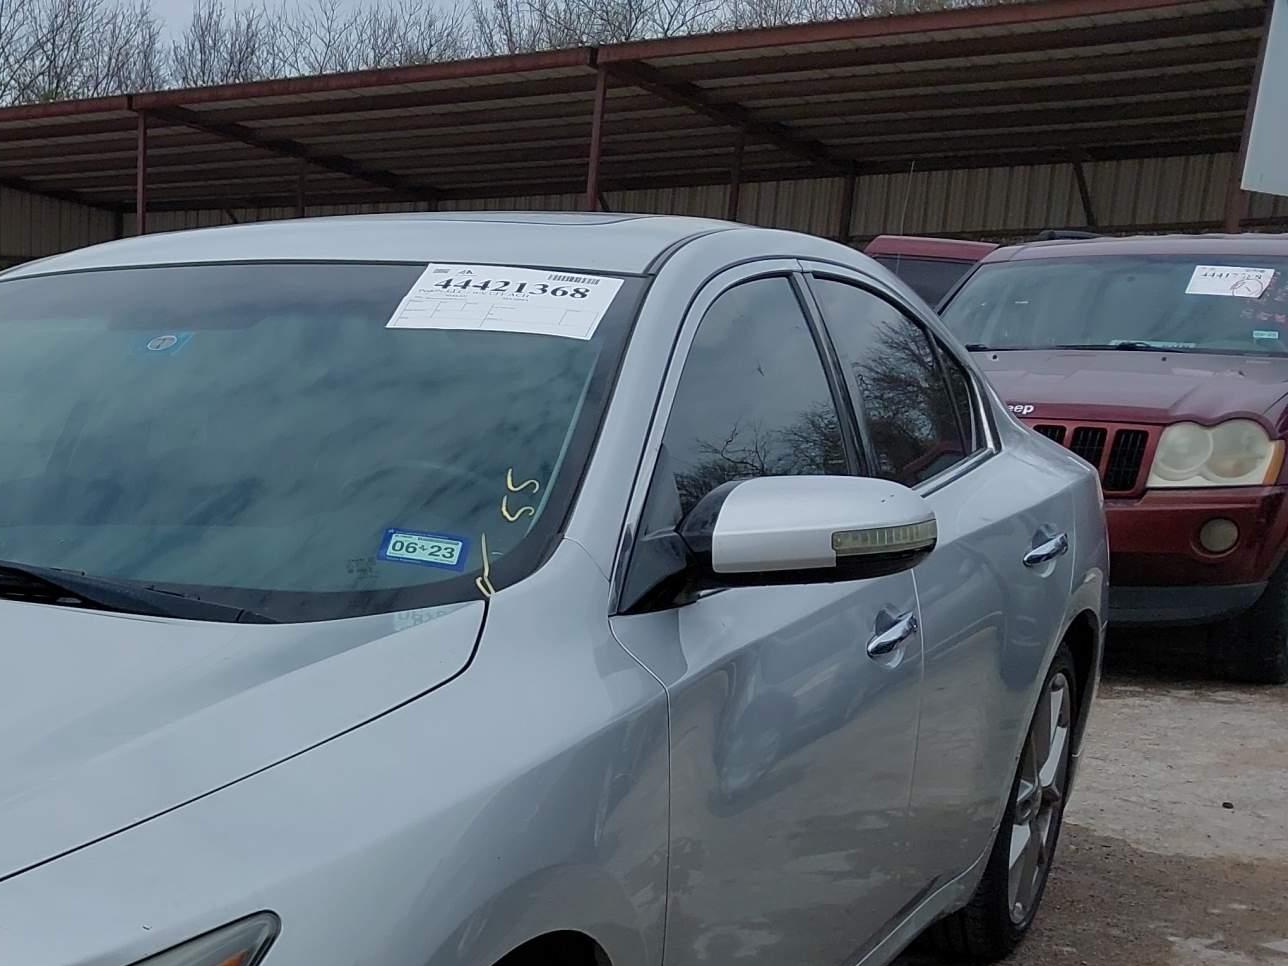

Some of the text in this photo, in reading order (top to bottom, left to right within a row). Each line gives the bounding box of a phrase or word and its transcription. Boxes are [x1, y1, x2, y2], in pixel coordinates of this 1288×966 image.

[434, 278, 590, 299] 44421368
[391, 539, 419, 555] 06
[427, 544, 456, 560] 23
